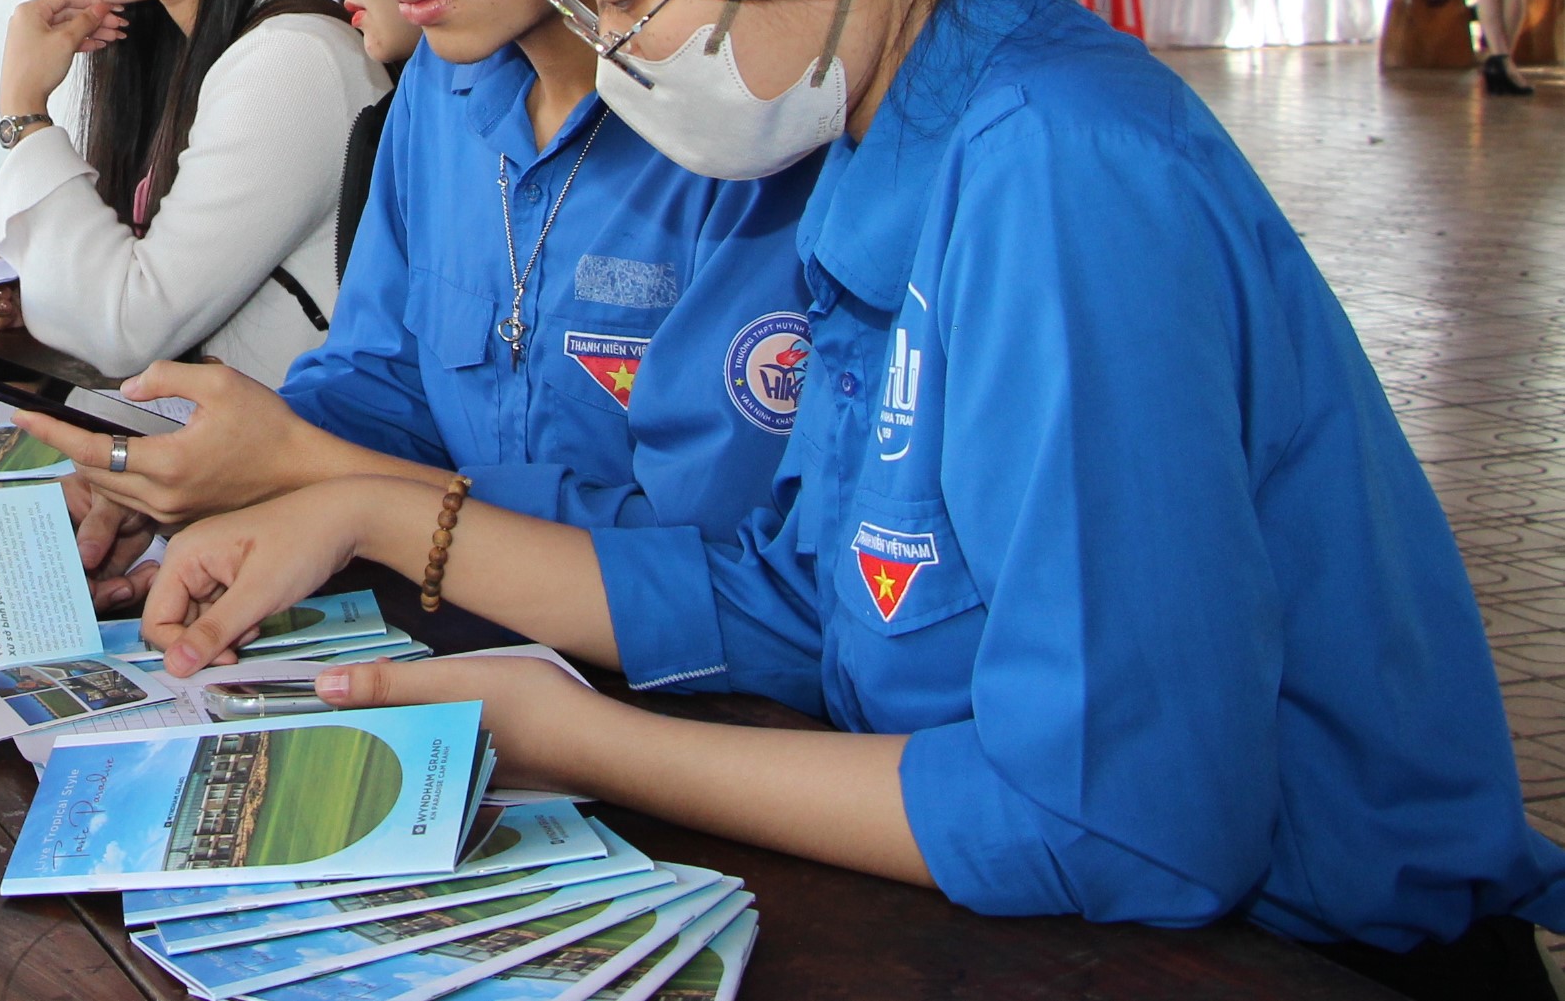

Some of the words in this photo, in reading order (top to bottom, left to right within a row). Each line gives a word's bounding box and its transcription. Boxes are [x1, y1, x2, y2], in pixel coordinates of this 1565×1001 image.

[753, 323, 773, 338] THPT
[570, 339, 600, 353] THANH
[602, 341, 626, 356] NIÊN
[885, 537, 902, 559] VIỆT
[902, 543, 931, 558] NAM
[442, 746, 451, 763] RANH
[416, 774, 436, 823] WYNDHAM
[428, 738, 443, 771] GRAND
[438, 765, 447, 779] CAM
[69, 757, 115, 828] Paradise
[433, 780, 444, 811] PARADISE
[35, 846, 51, 873] Live
[44, 800, 68, 844] Tropical
[61, 768, 80, 796] Style
[53, 826, 90, 870] Taste
